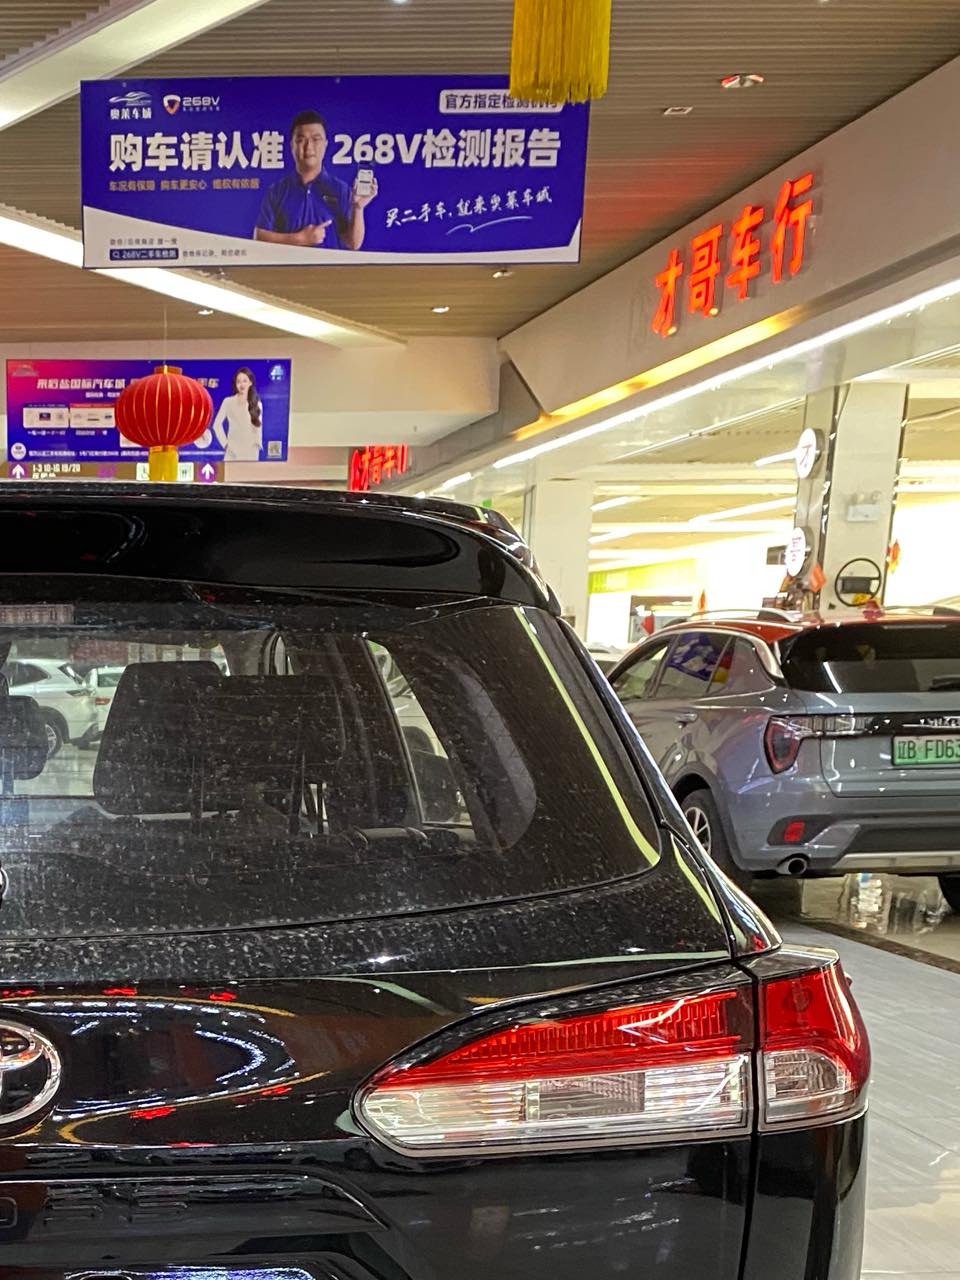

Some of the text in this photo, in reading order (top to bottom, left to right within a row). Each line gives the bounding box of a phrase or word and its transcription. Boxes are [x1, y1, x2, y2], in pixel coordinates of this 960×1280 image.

[182, 96, 221, 107] 268V
[445, 94, 558, 109] 官方指定检
[110, 107, 152, 120] 奥莱车城
[109, 128, 562, 172] 购车请认准 268V检测报告
[652, 171, 814, 337] 才哥车行
